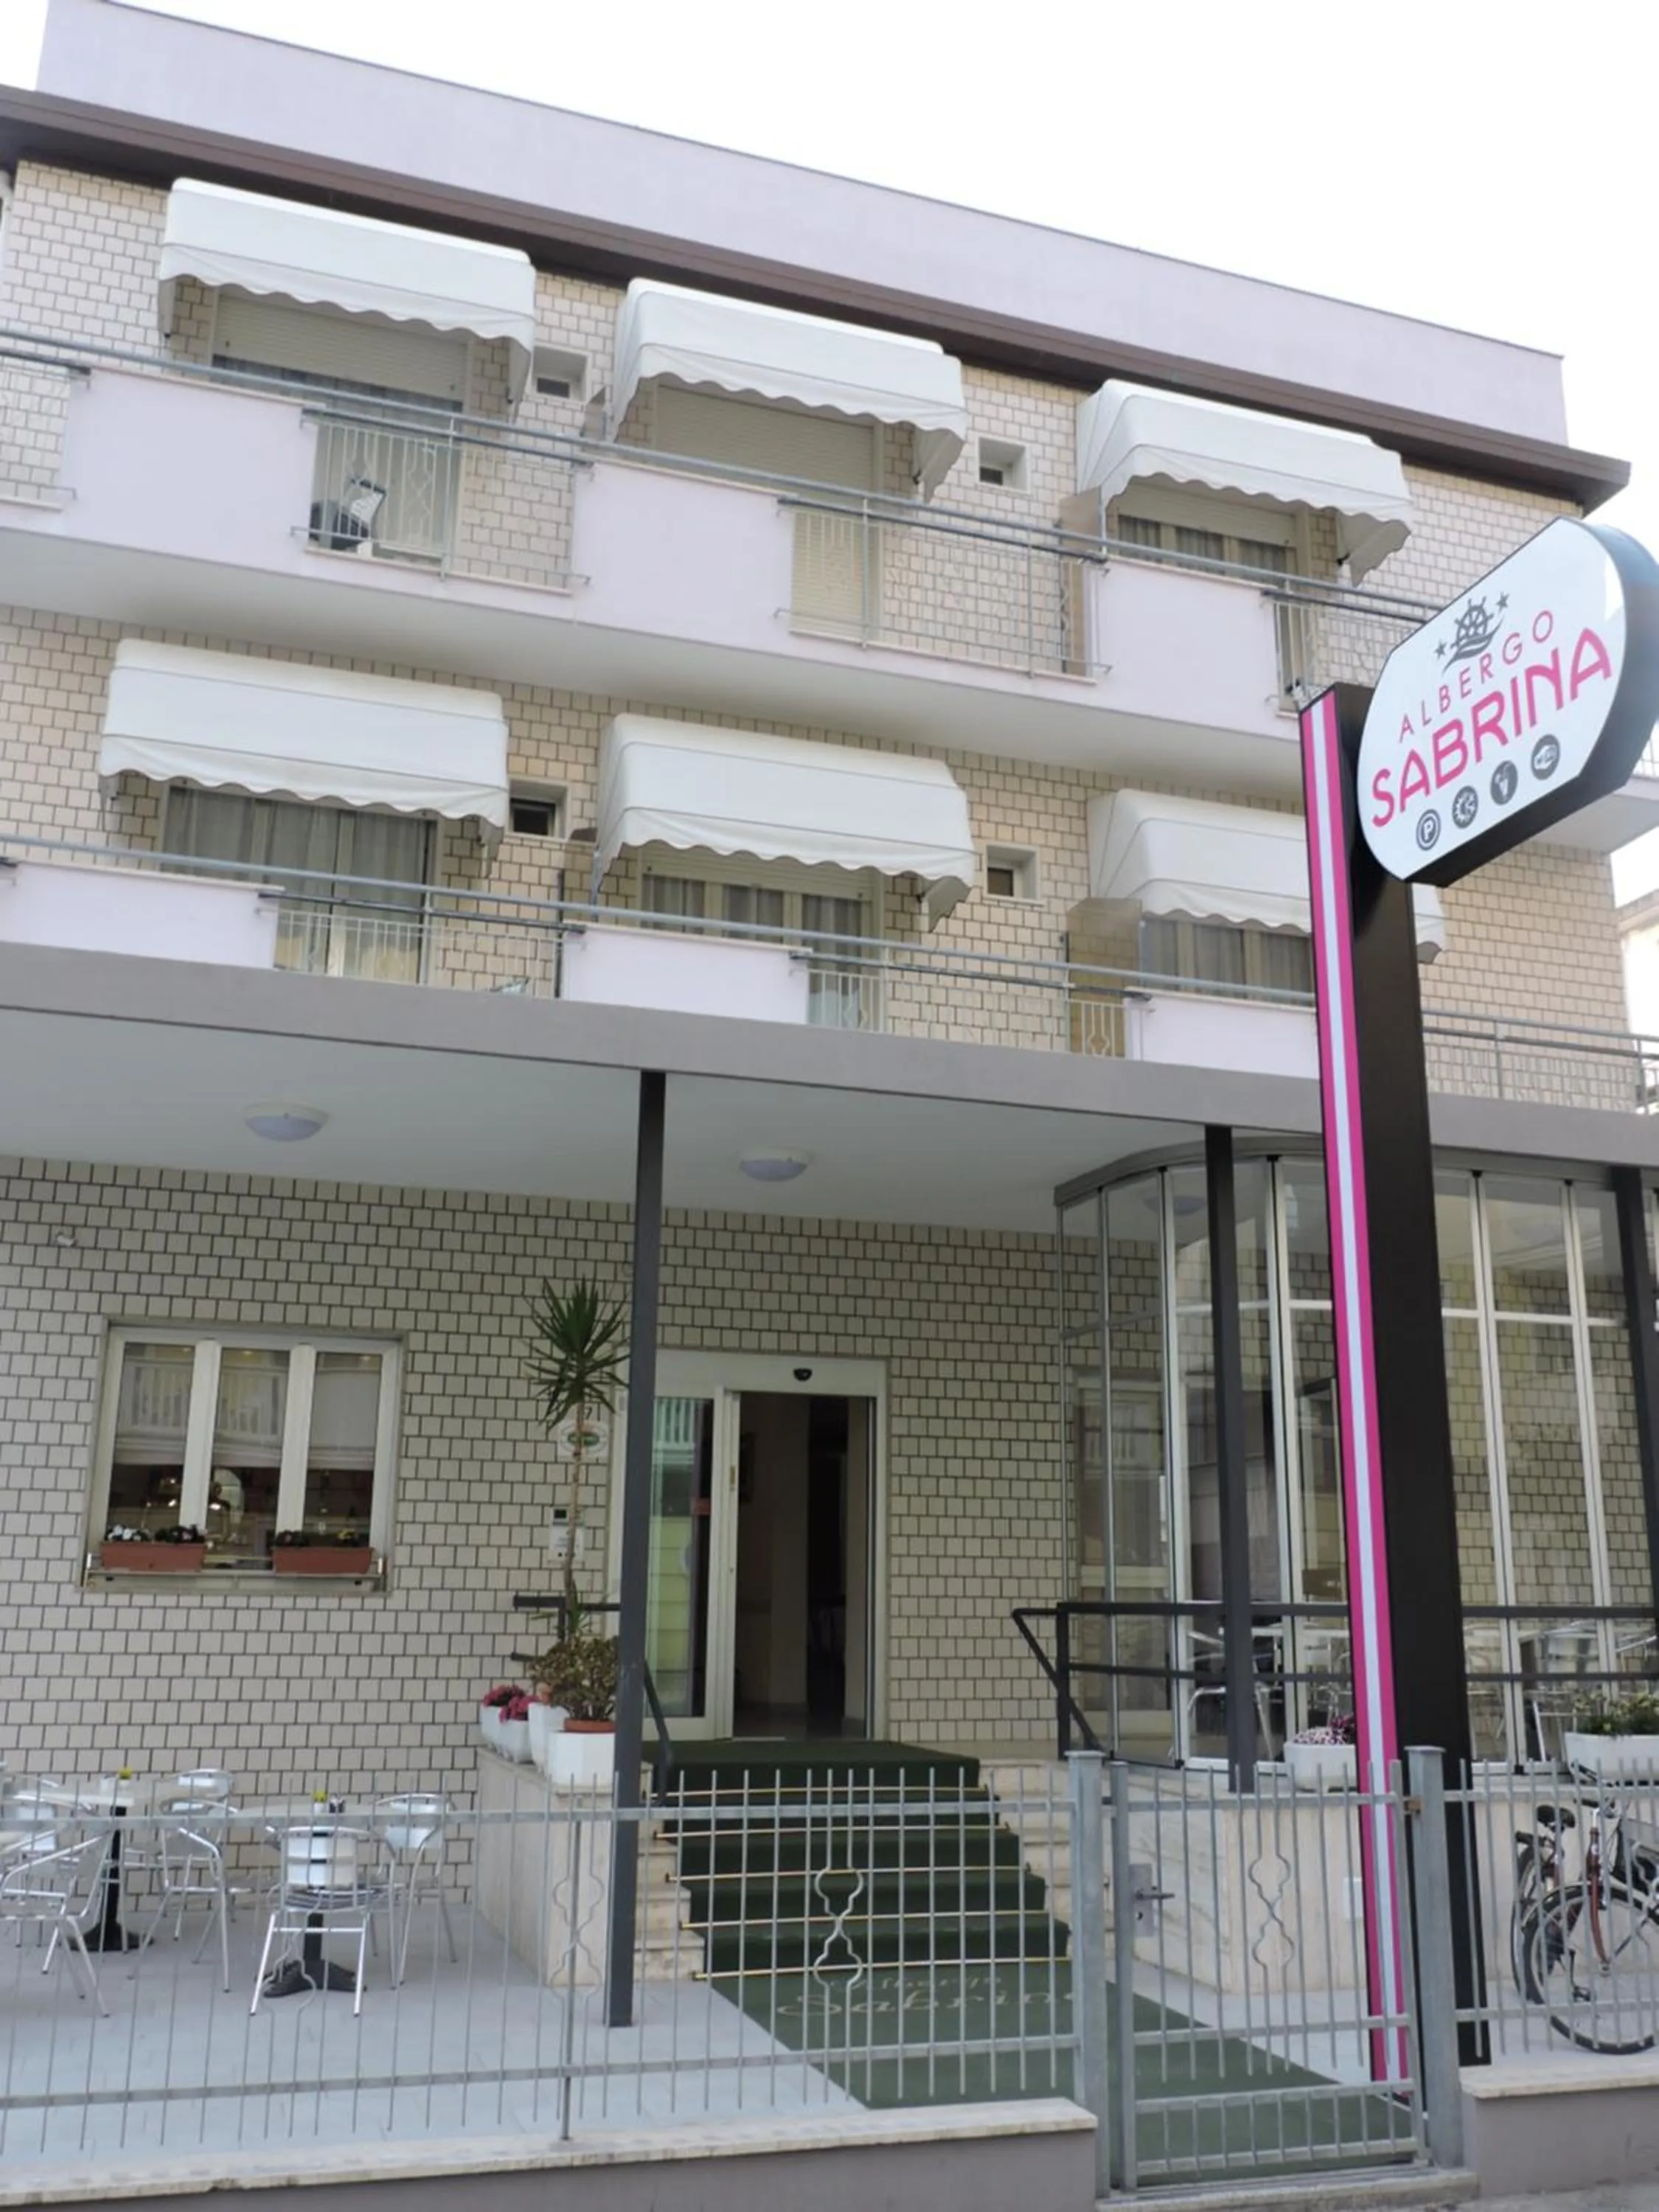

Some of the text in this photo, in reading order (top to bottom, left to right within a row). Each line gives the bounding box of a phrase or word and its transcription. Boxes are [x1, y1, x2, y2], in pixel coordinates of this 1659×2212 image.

[1371, 627, 1612, 827] SABRINA
[1399, 610, 1554, 743] ALBERGO
[776, 1989, 1074, 2017] Sabrin
